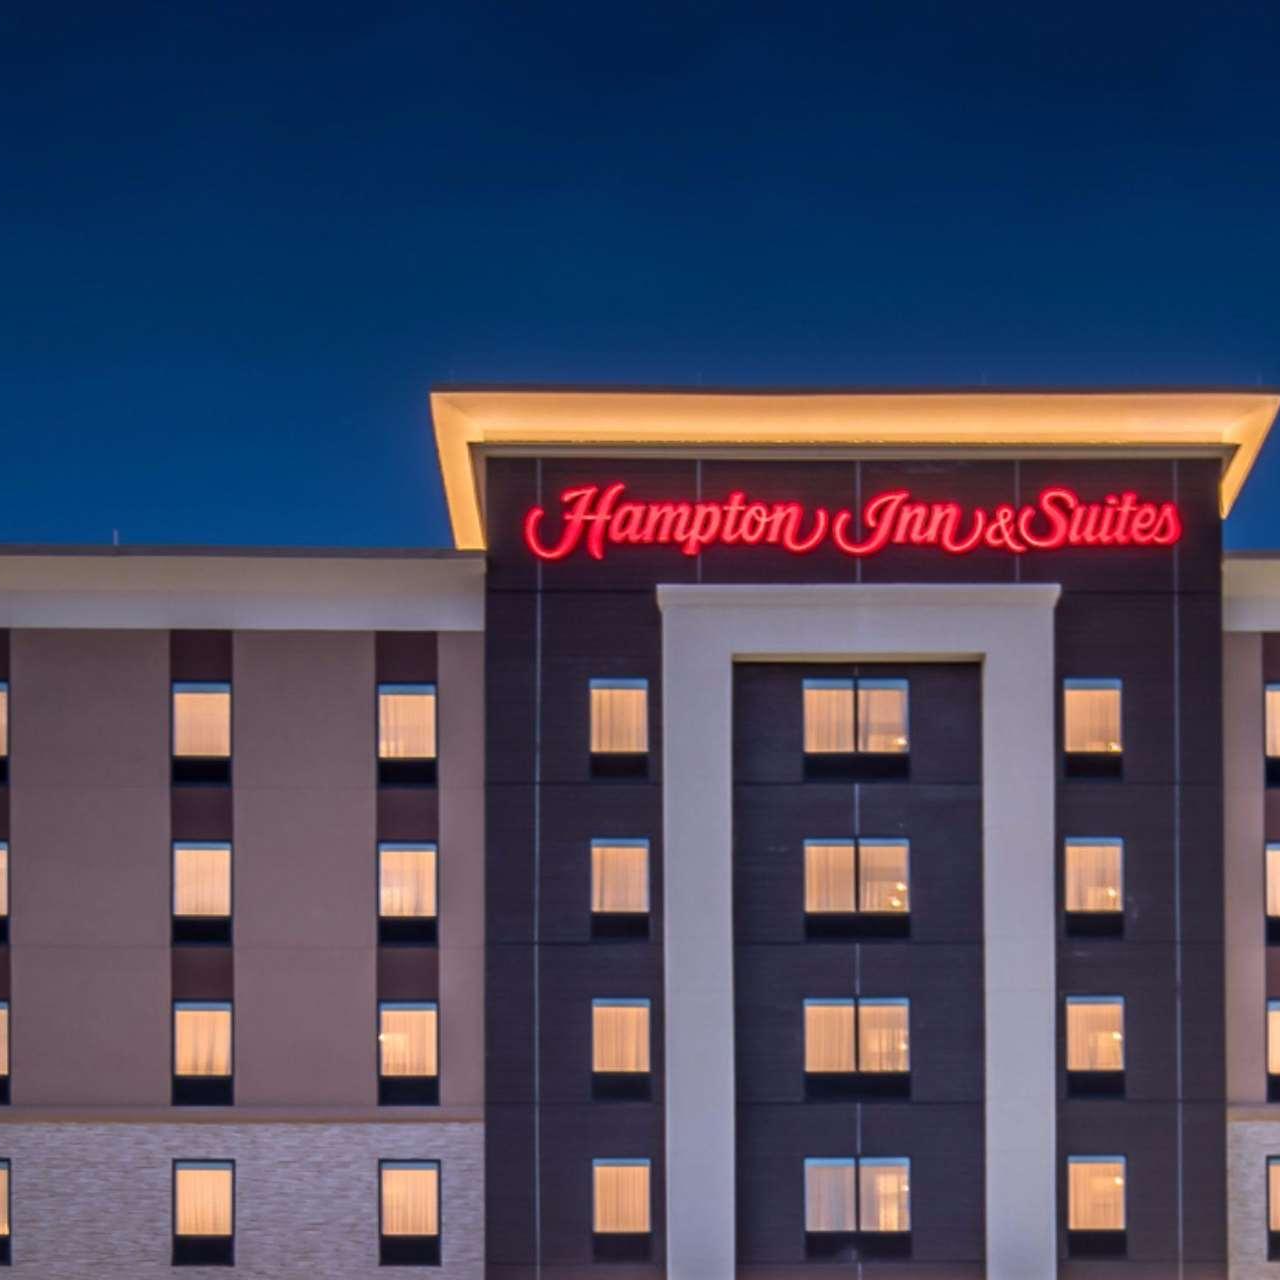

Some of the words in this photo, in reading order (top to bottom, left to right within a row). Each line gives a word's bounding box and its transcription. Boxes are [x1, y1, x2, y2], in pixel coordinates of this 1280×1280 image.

[524, 482, 829, 560] Hampton
[831, 489, 984, 555] Inn
[984, 505, 1027, 553] &
[1017, 487, 1182, 549] Suites
